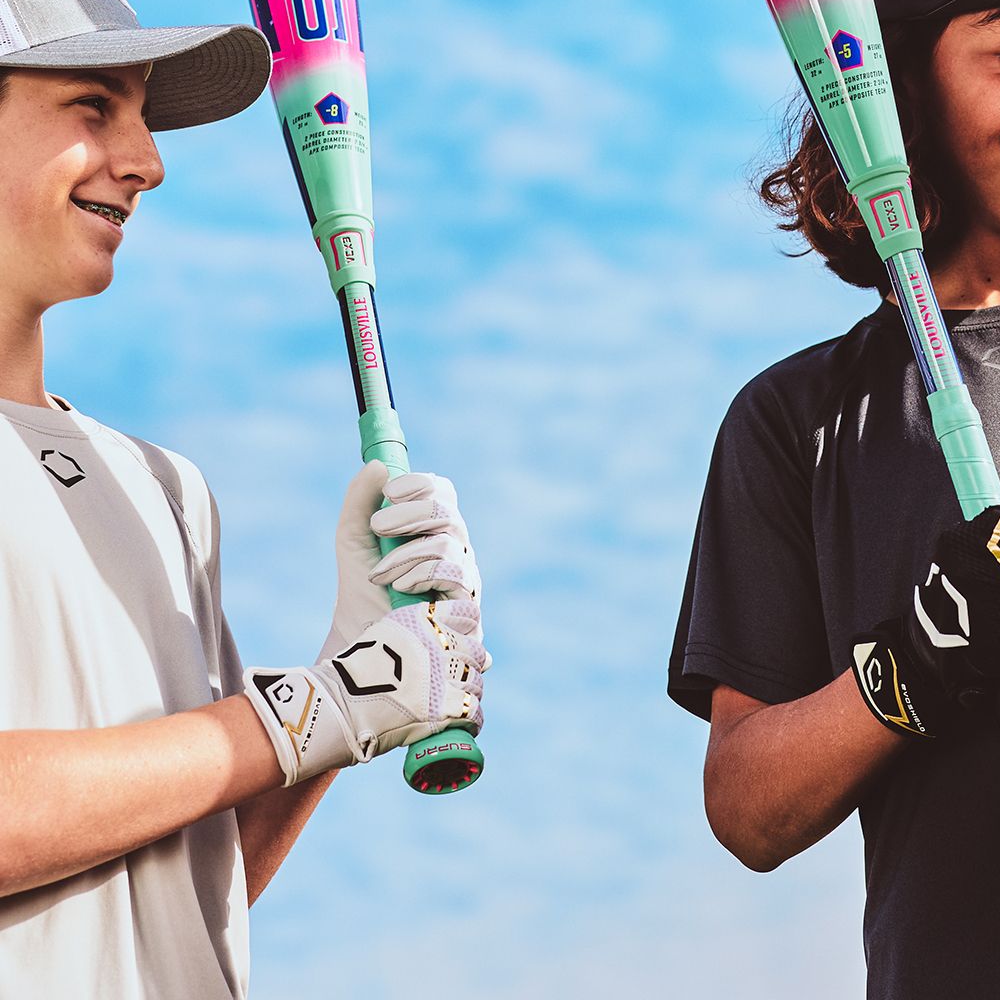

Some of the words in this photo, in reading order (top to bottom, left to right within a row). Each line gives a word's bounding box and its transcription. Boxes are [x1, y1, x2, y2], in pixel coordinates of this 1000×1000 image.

[838, 43, 852, 59] -5
[844, 70, 883, 85] CONSTRUCTION
[820, 90, 840, 103] BARREL
[841, 81, 873, 95] DAMETER:
[828, 99, 839, 109] APX
[840, 90, 874, 105] CMPOSITE
[325, 104, 339, 117] -8
[309, 130, 326, 140] PIECE
[302, 140, 322, 151] BARREL
[909, 270, 946, 359] LOUISVILLE
[353, 296, 379, 369] LOUISVILLE
[415, 742, 473, 760] SUPRA
